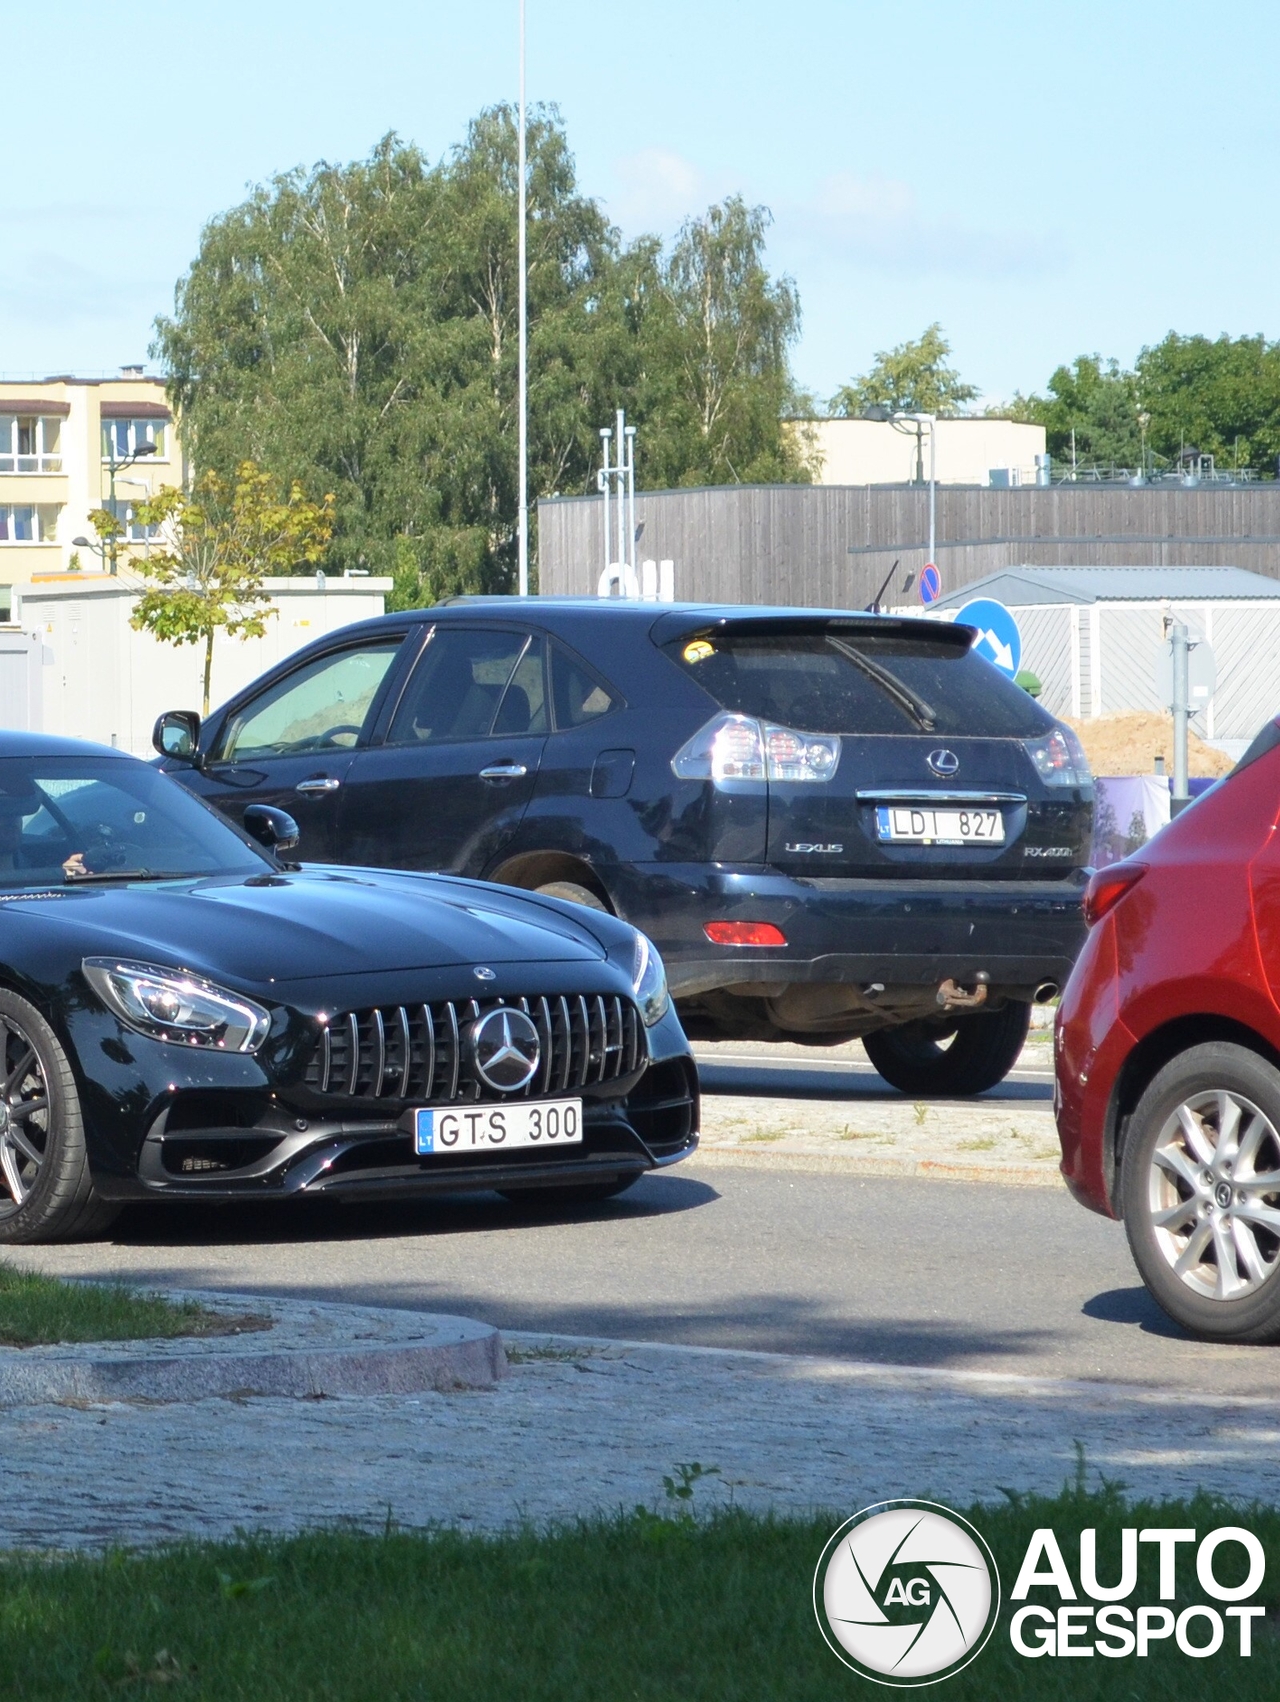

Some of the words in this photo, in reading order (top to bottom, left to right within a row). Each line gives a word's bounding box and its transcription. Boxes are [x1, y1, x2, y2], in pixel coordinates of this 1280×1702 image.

[893, 810, 938, 836] LDI
[959, 811, 998, 837] 827
[785, 843, 844, 853] LEXUS
[420, 1136, 432, 1146] LT
[439, 1111, 507, 1147] GTS
[529, 1106, 577, 1141] 300
